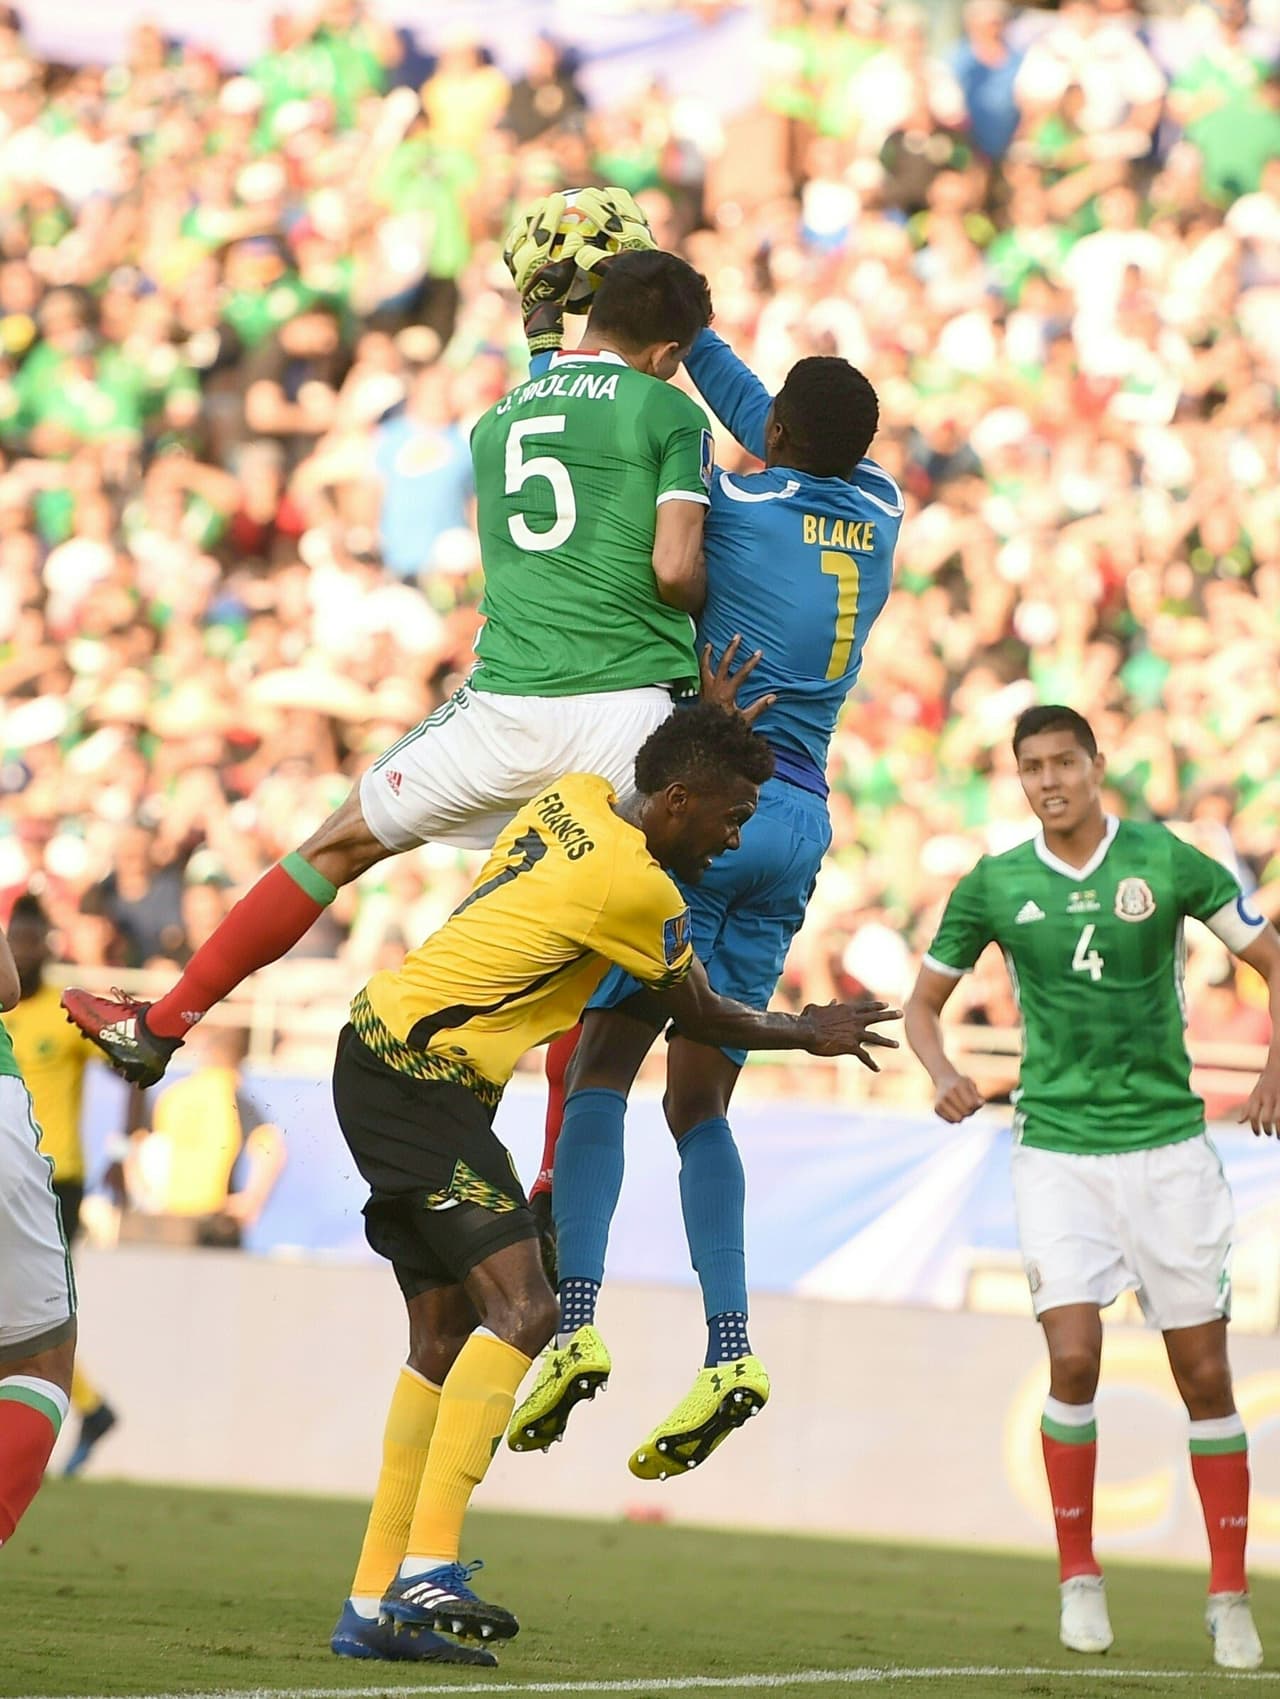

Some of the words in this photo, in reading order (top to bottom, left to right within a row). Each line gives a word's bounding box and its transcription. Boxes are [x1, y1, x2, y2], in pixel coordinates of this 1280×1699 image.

[515, 374, 620, 404] MOLINA
[504, 415, 577, 551] 5
[803, 514, 875, 551] BLAKE
[820, 550, 860, 681] 1
[534, 792, 595, 861] FRANCIS
[1072, 924, 1105, 981] 4
